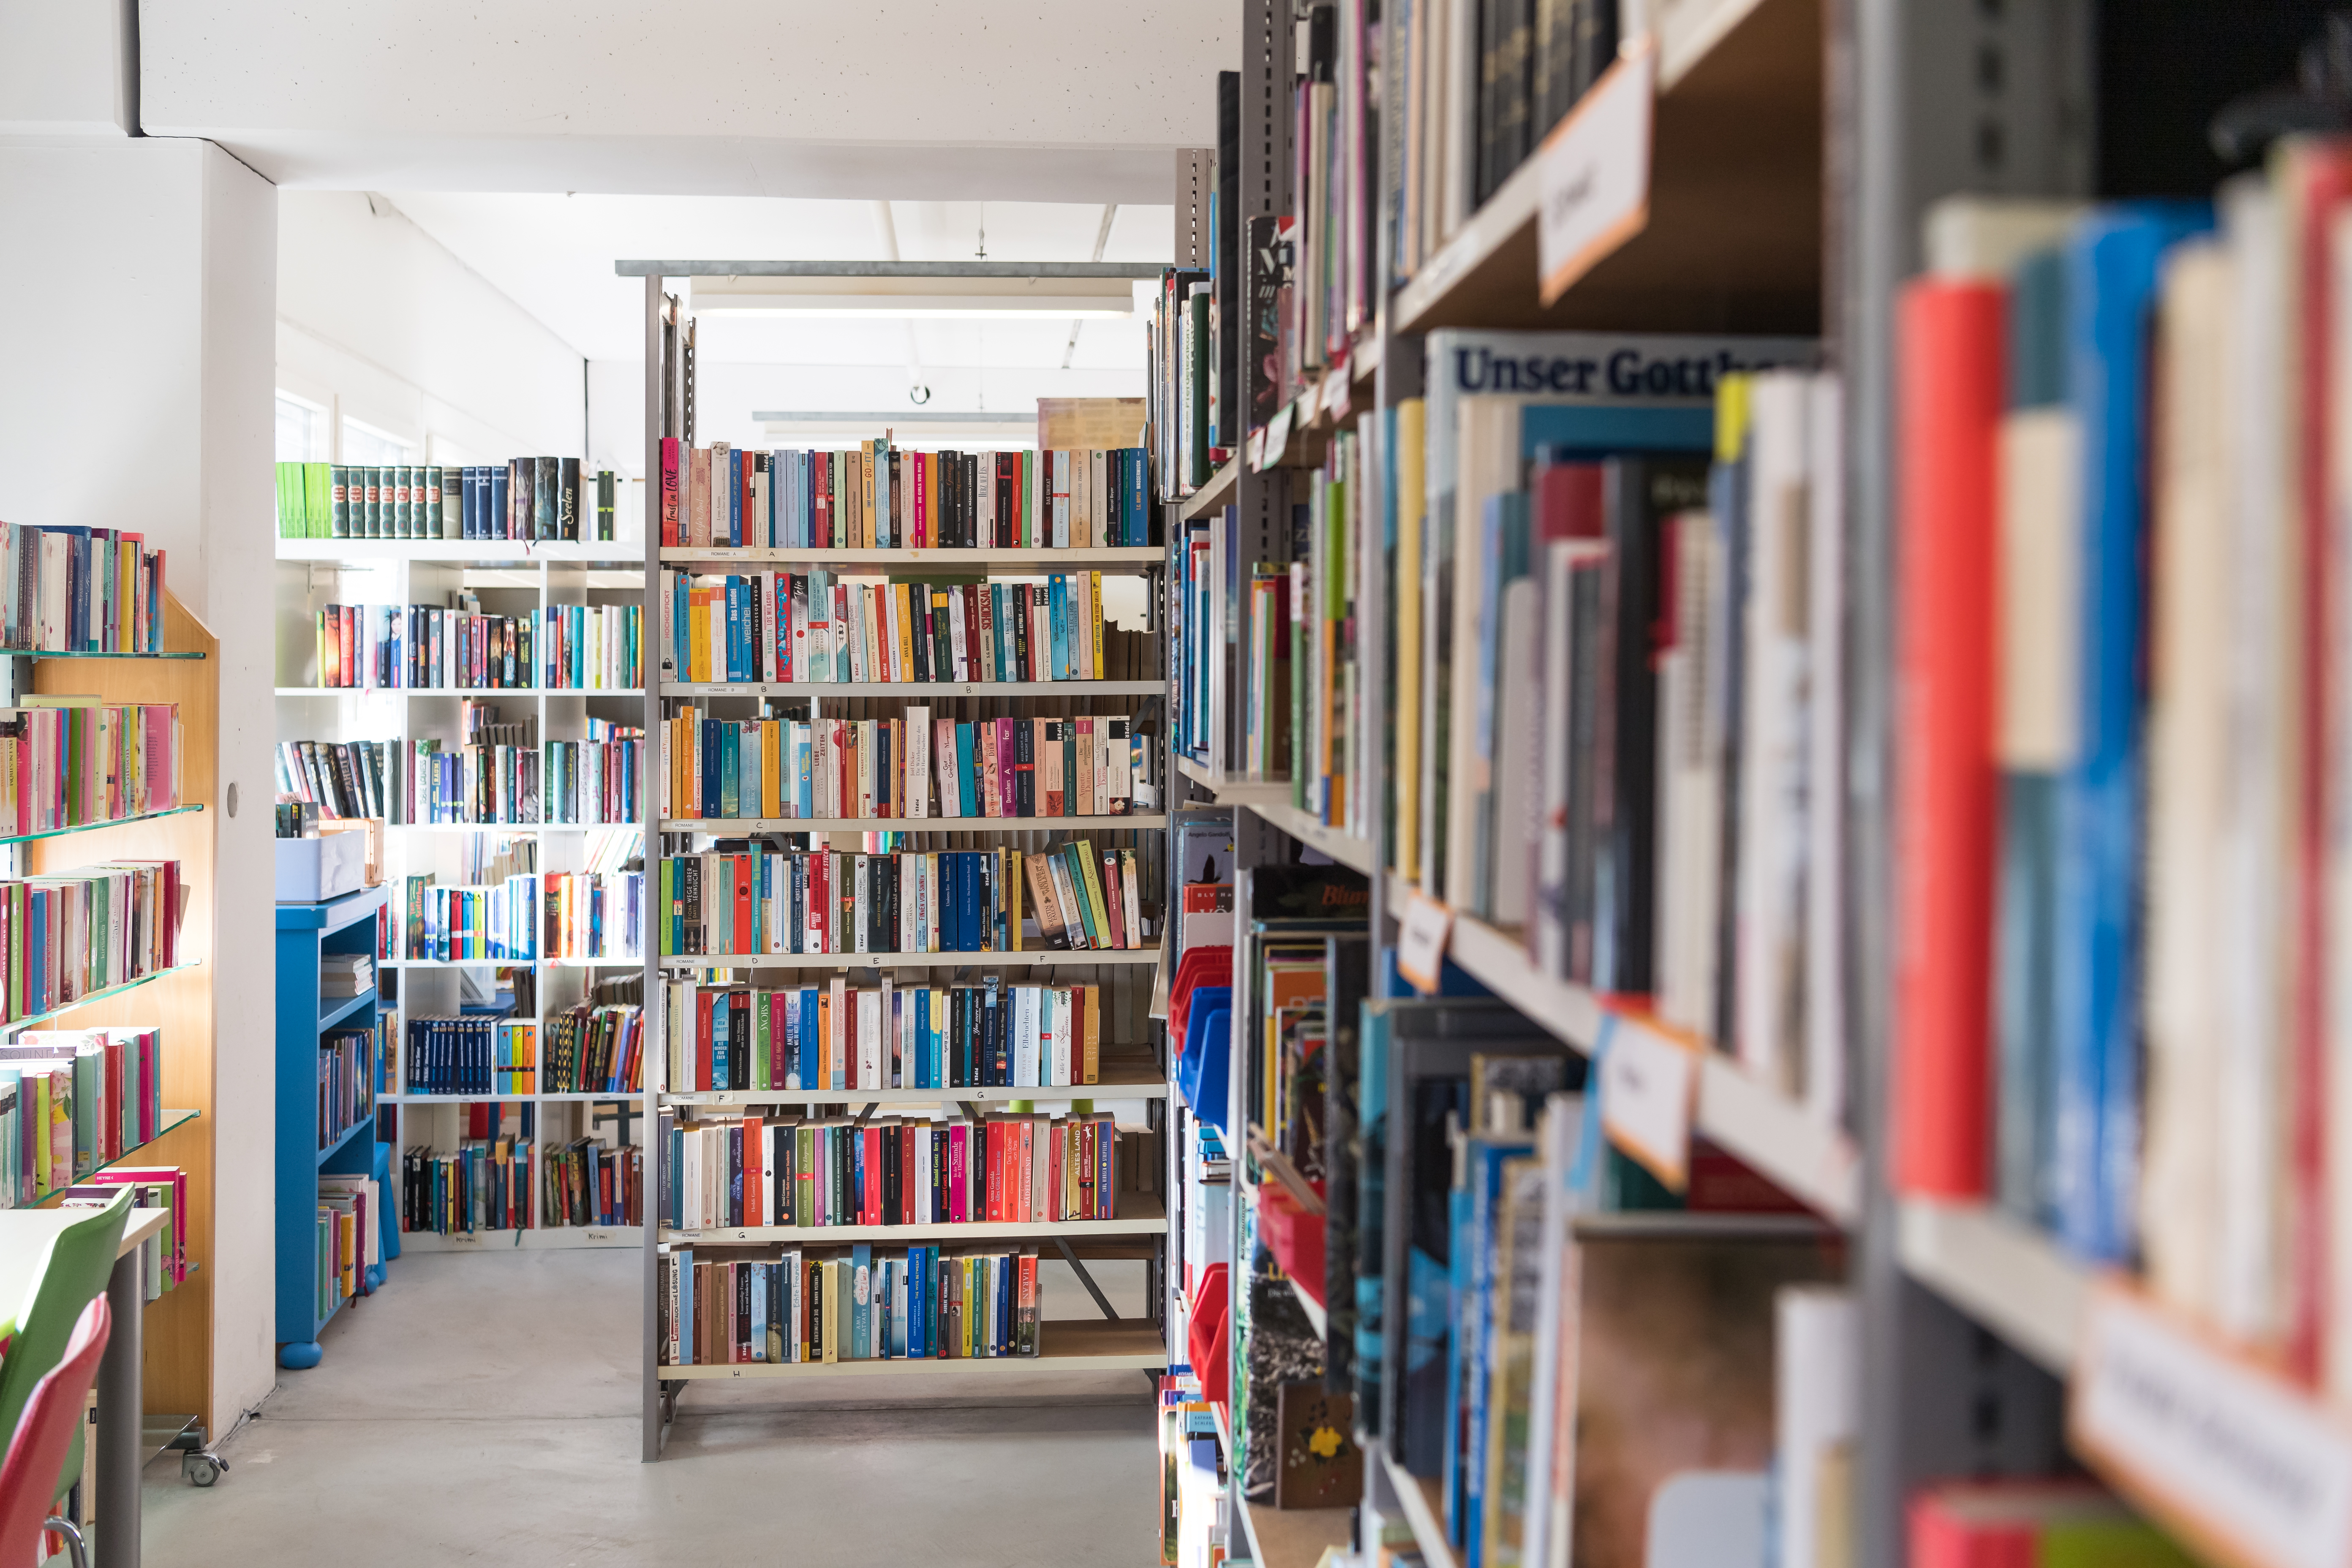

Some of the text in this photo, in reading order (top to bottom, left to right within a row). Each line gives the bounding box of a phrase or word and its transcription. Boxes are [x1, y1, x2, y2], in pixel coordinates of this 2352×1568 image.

[1456, 348, 1596, 392] Unser
[665, 468, 677, 491] LOVE
[560, 487, 574, 524] Seelen
[666, 502, 677, 522] Trust
[980, 588, 992, 630] SCHICKSAL
[742, 607, 751, 644] weichei
[1038, 866, 1050, 895] WOLKEN
[1045, 906, 1054, 927] KRISTIN
[760, 1004, 768, 1034] SNOBS
